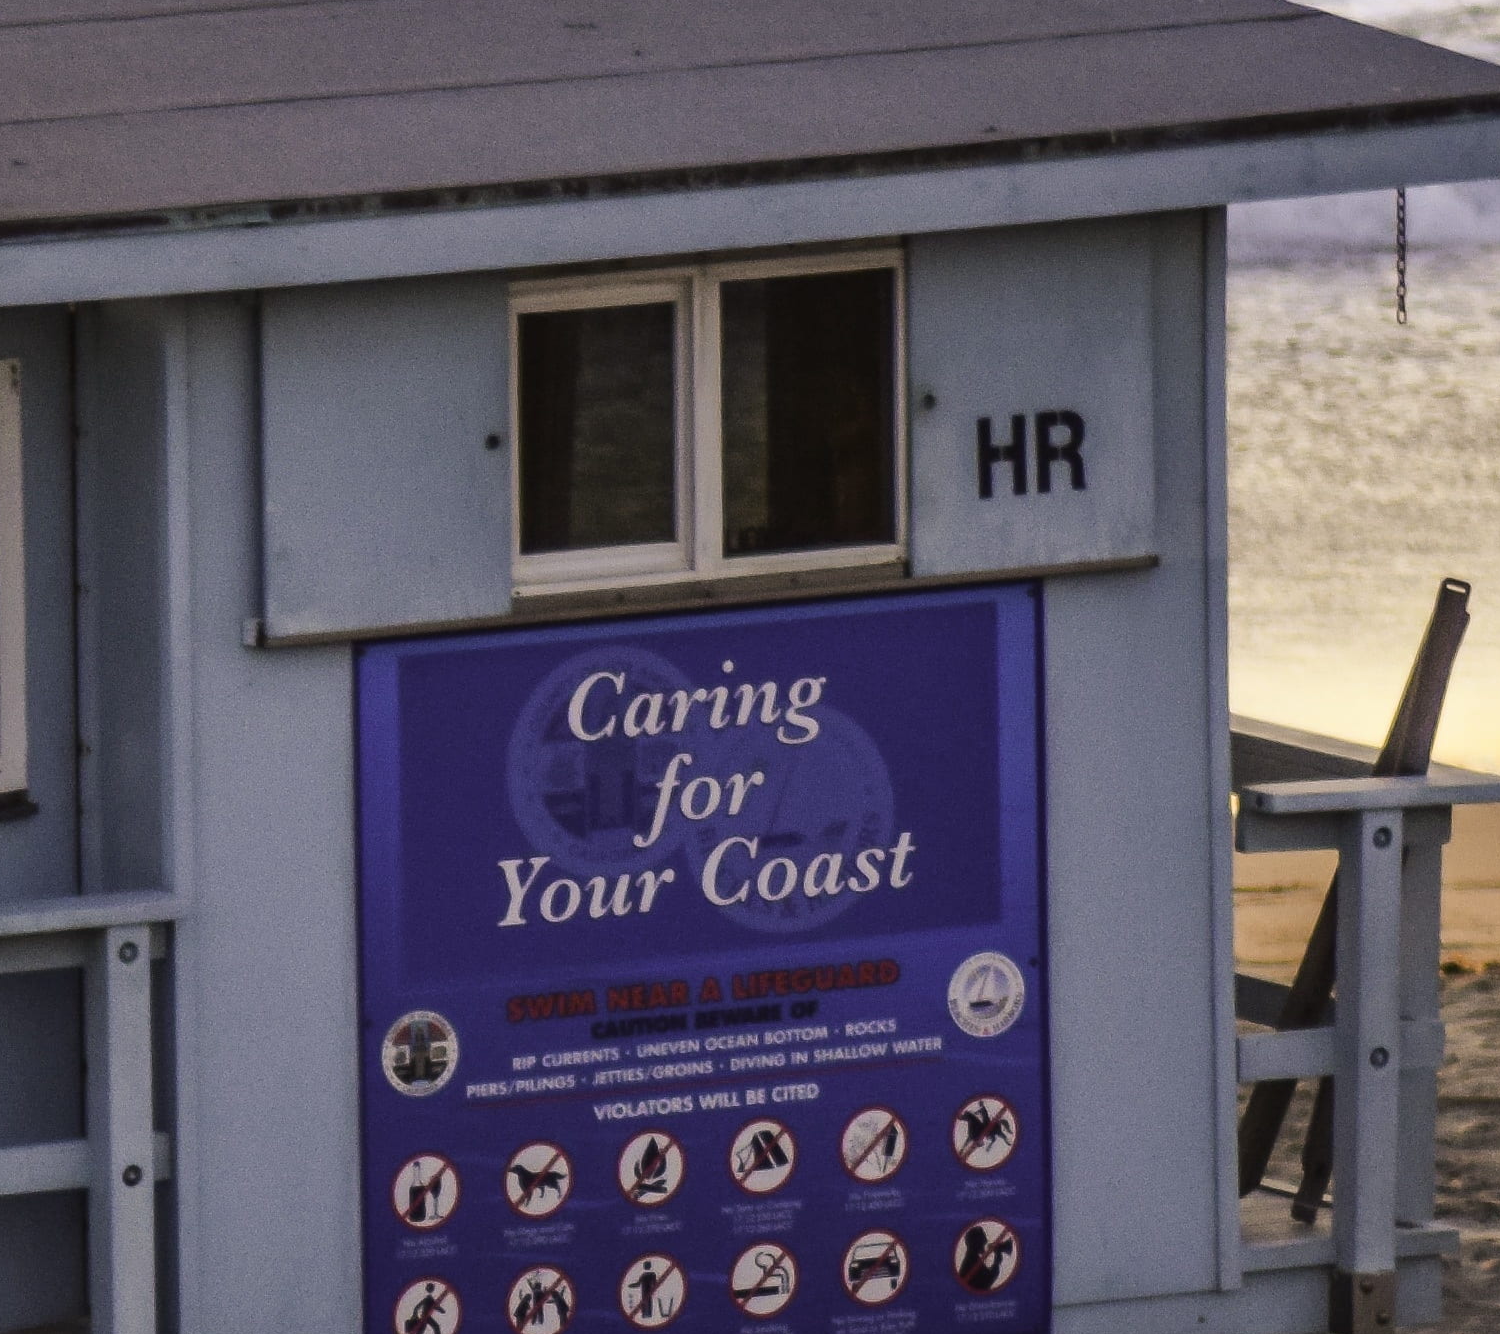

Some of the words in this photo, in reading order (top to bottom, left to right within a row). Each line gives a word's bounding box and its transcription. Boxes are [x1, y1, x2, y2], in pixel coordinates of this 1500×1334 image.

[976, 409, 1086, 499] HR
[567, 659, 827, 745] Caring
[632, 753, 766, 848] for
[496, 856, 676, 928] Your
[702, 832, 917, 907] Coast
[507, 989, 597, 1024] SWIM
[606, 979, 689, 1012] NEAR
[700, 976, 722, 1003] A
[732, 958, 900, 1000] LIFEGUARD
[512, 1055, 536, 1071] RIP
[542, 1047, 620, 1068] CURRENTS
[636, 1039, 700, 1058] UNEVEN
[705, 1033, 759, 1051] OCEAN
[764, 1026, 828, 1045] BOTTOM
[845, 1019, 897, 1037] ROCKS
[730, 1053, 786, 1072] DIVING
[791, 1051, 809, 1065] IN
[813, 1043, 888, 1063] SHALLOW
[892, 1036, 943, 1055] WATER
[594, 1095, 694, 1121] VIOLATORS
[699, 1092, 740, 1110] WILL
[746, 1088, 766, 1105] BE
[771, 1083, 820, 1103] CITED
